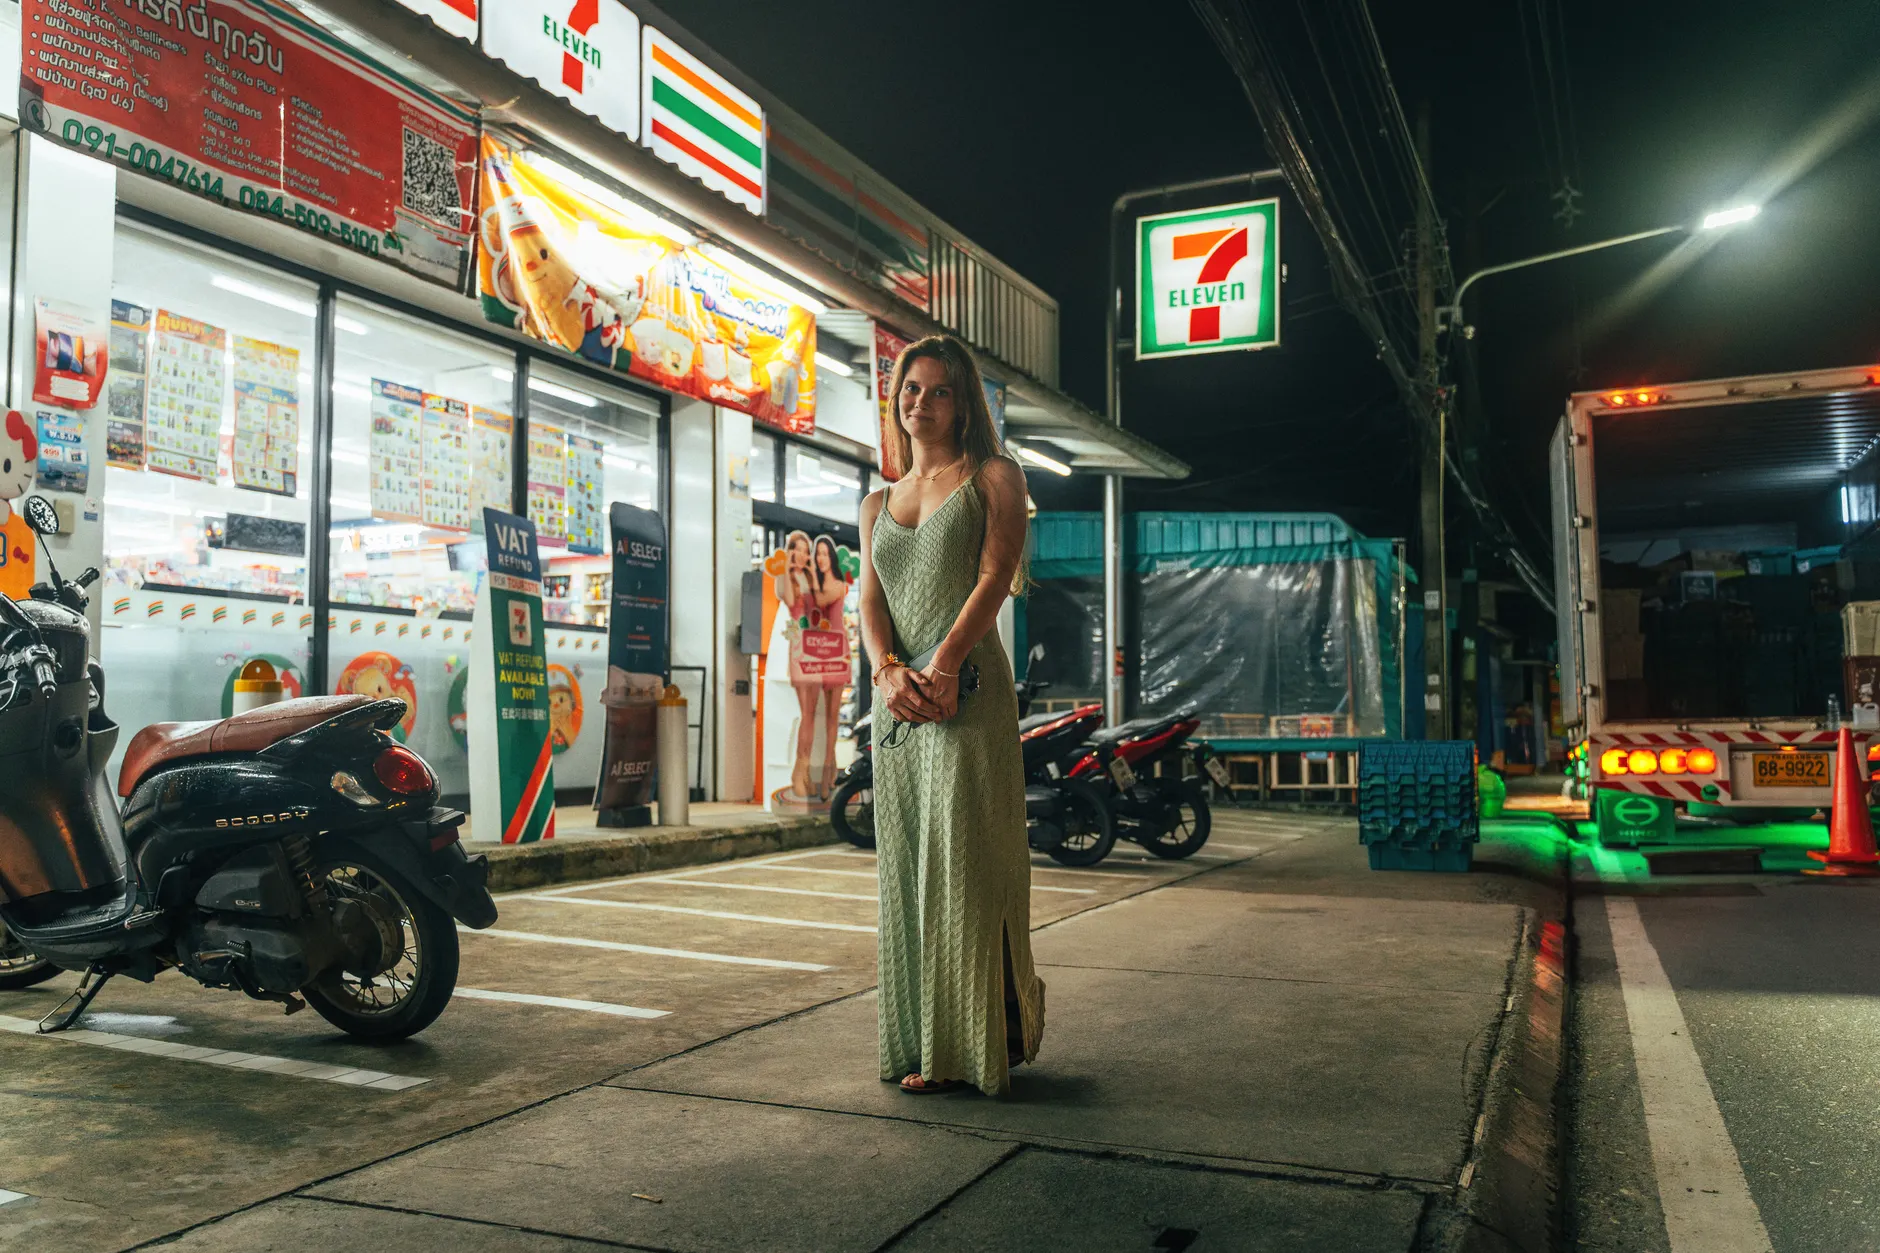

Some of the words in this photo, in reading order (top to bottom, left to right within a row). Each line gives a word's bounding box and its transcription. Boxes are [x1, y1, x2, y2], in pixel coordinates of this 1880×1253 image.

[95, 51, 118, 69] Part
[256, 78, 277, 96] Plus
[494, 523, 529, 556] VAT
[630, 541, 662, 561] SELECT
[498, 553, 533, 573] REFUND
[498, 652, 513, 666] VAT
[515, 652, 544, 669] REFUND
[500, 669, 545, 686] AVAILABLE
[512, 687, 536, 701] NOW!
[623, 761, 652, 776] SELECT
[215, 810, 309, 828] SCOOPY
